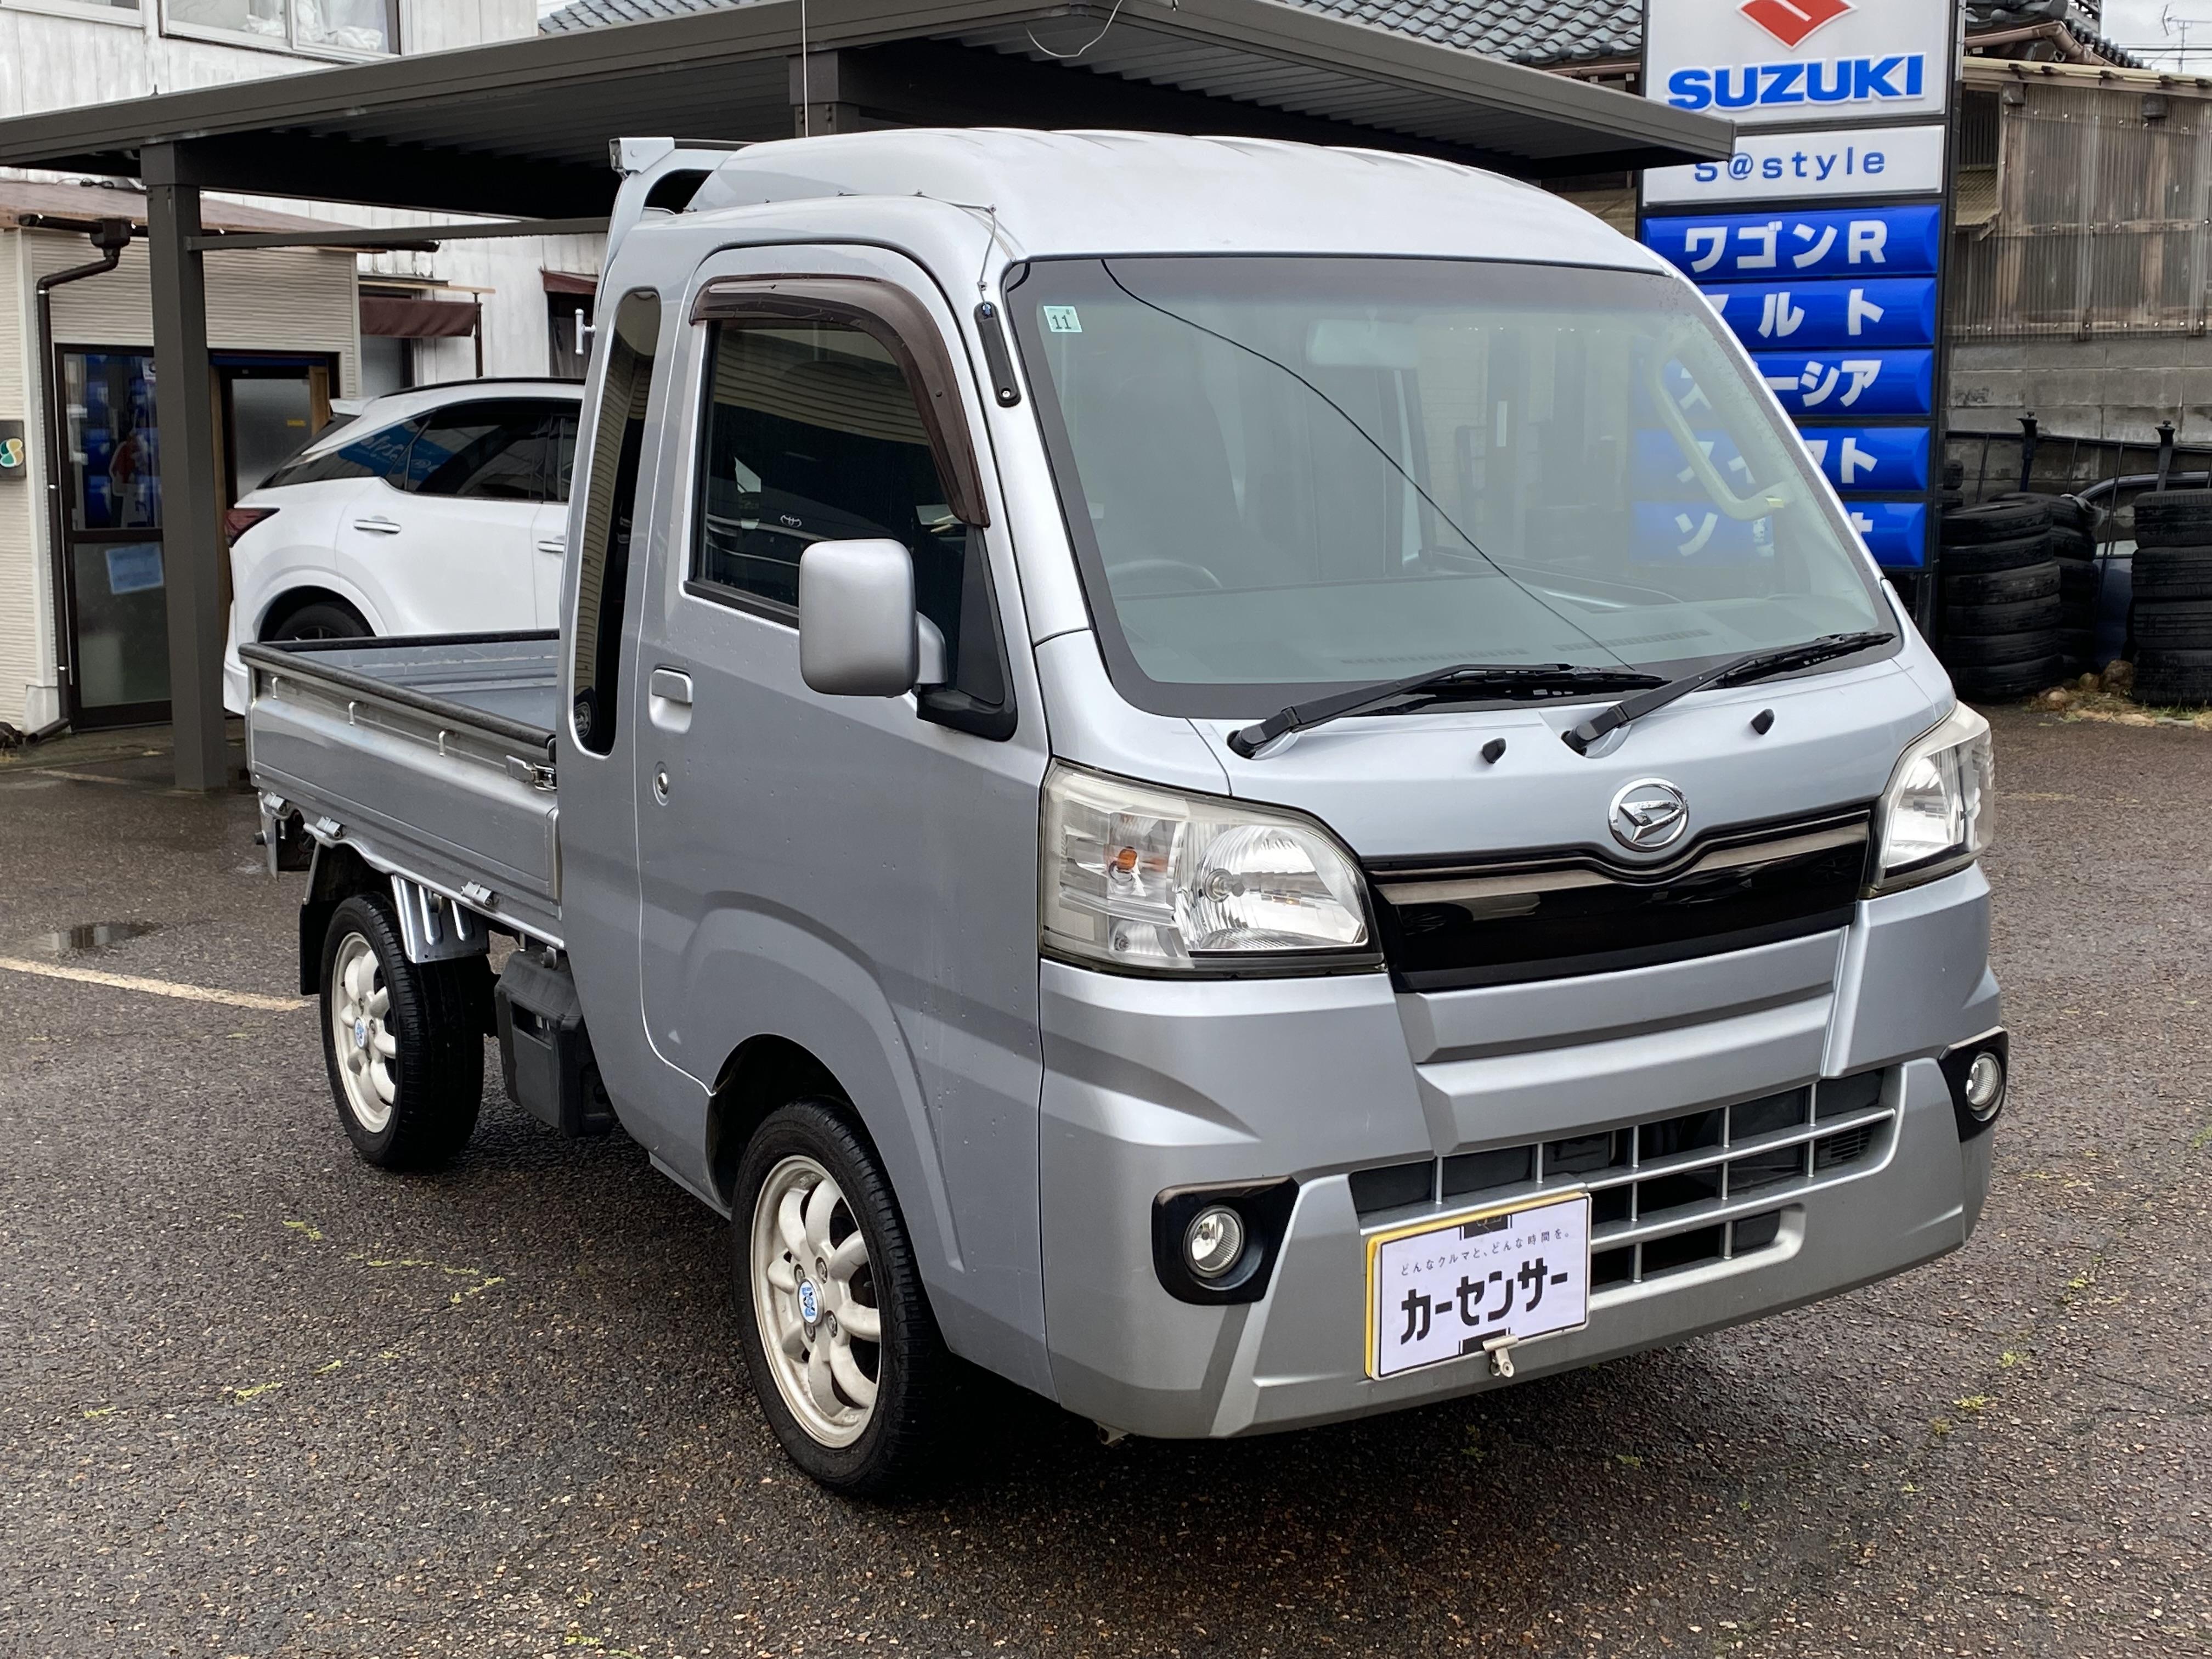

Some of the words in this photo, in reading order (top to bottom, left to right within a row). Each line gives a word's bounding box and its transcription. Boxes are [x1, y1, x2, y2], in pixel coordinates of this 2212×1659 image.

[1668, 54, 1925, 110] SUZUKI
[1685, 221, 1887, 273] ワゴンR
[1053, 315, 1071, 329] 11
[1401, 1257, 1568, 1345] カーセンサー
